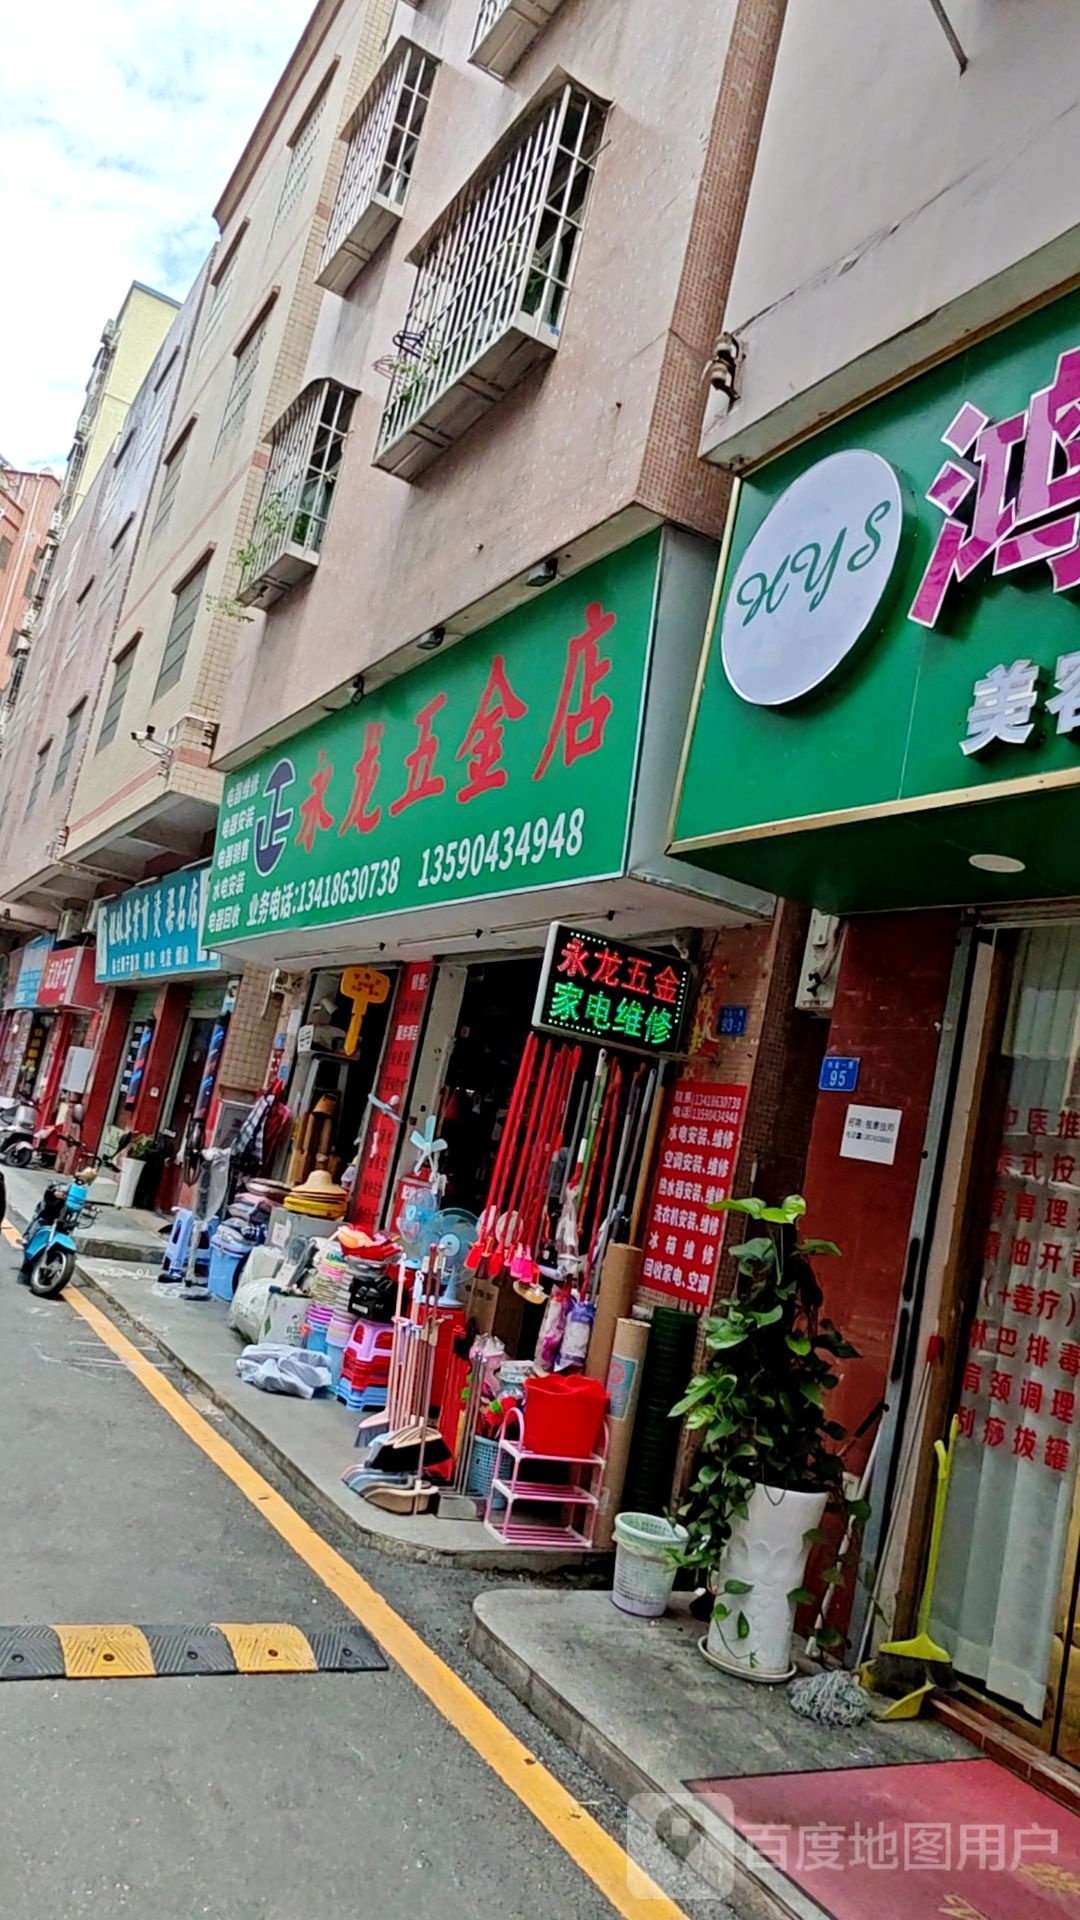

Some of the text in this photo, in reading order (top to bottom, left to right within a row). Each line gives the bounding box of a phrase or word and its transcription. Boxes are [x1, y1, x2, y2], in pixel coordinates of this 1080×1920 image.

[907, 346, 1080, 628] 鸿
[295, 602, 616, 853] 永龙五金店
[221, 806, 256, 839] 电器安装
[217, 838, 249, 870] 电器销售
[417, 808, 585, 887] 13590434948
[212, 870, 246, 901] 水电安装
[208, 903, 241, 933] 电器回收
[557, 937, 681, 1004] 永龙五金
[549, 981, 673, 1045] 家电维修
[829, 1069, 847, 1087] 95
[668, 1123, 734, 1149] 水电安装、维修
[662, 1150, 729, 1178] 空调安装、维修
[653, 1203, 720, 1236] 洗衣机安装、维修
[643, 1257, 710, 1295] 回收家电、空调
[963, 1361, 1076, 1424] 肩颈调理
[957, 1404, 1071, 1472] 刮痧拔罐
